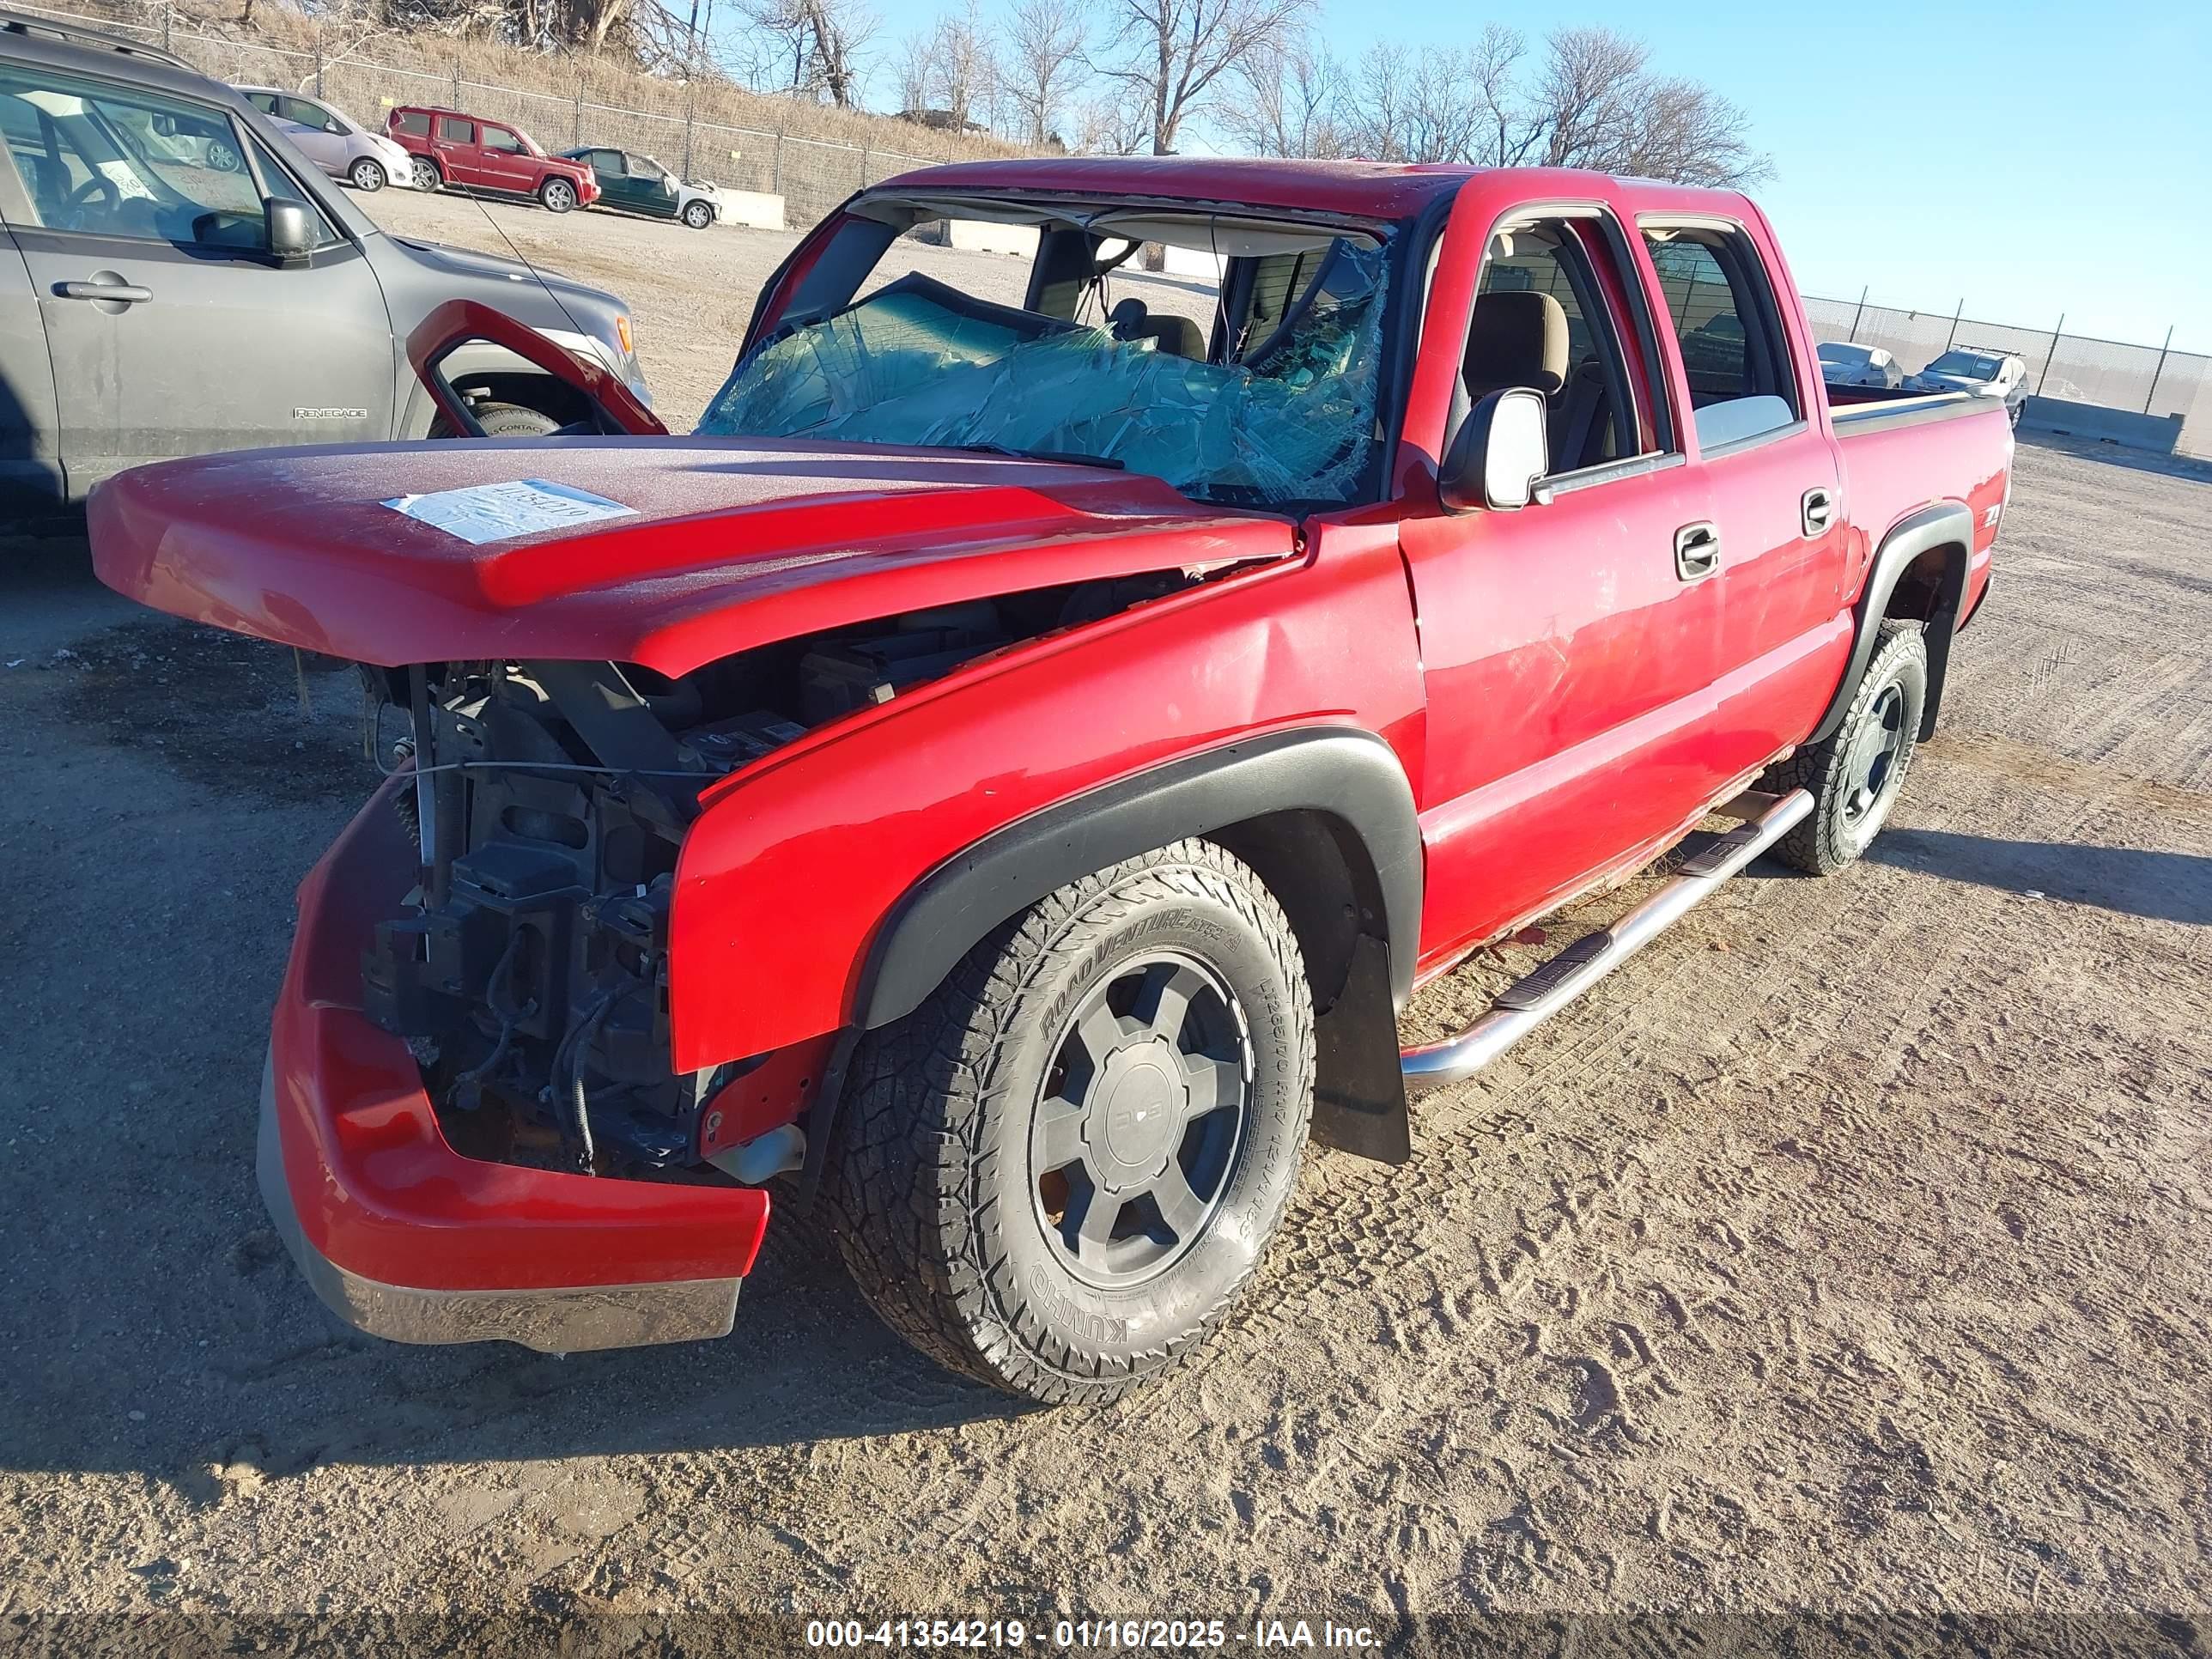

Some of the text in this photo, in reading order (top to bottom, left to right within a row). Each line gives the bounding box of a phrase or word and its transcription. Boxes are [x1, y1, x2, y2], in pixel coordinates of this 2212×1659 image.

[293, 407, 368, 419] RENEGADE
[1040, 957, 1093, 1042] ROAD
[1094, 906, 1194, 967] VENTURE
[1259, 978, 1289, 1073] LT265/70
[1274, 1080, 1289, 1127] R17
[1030, 1263, 1127, 1346] KUMHO
